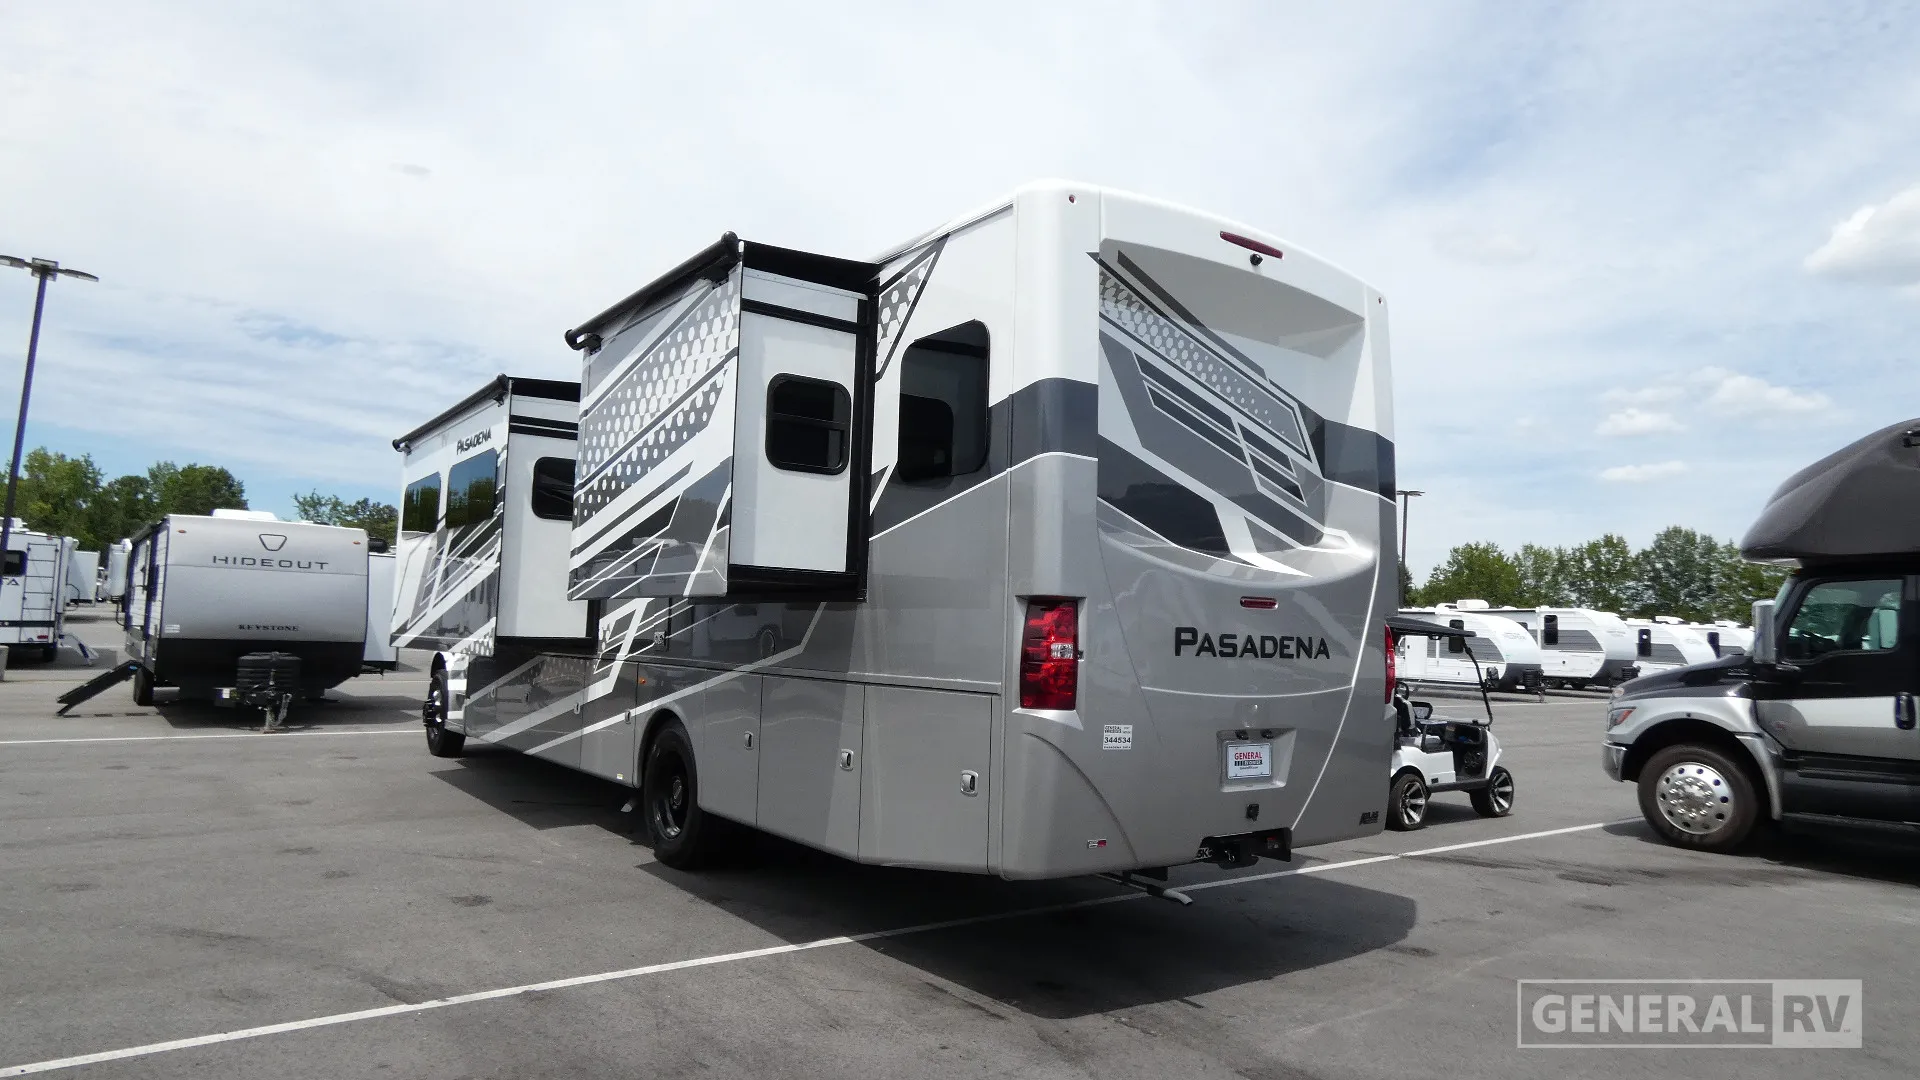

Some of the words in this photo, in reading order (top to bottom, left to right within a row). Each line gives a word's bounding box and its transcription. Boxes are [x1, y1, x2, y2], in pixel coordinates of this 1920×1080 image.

[456, 427, 493, 454] PASADENA
[212, 555, 329, 570] HIDEOUT
[1174, 626, 1331, 660] PASADENA
[1234, 751, 1262, 760] GENERAL
